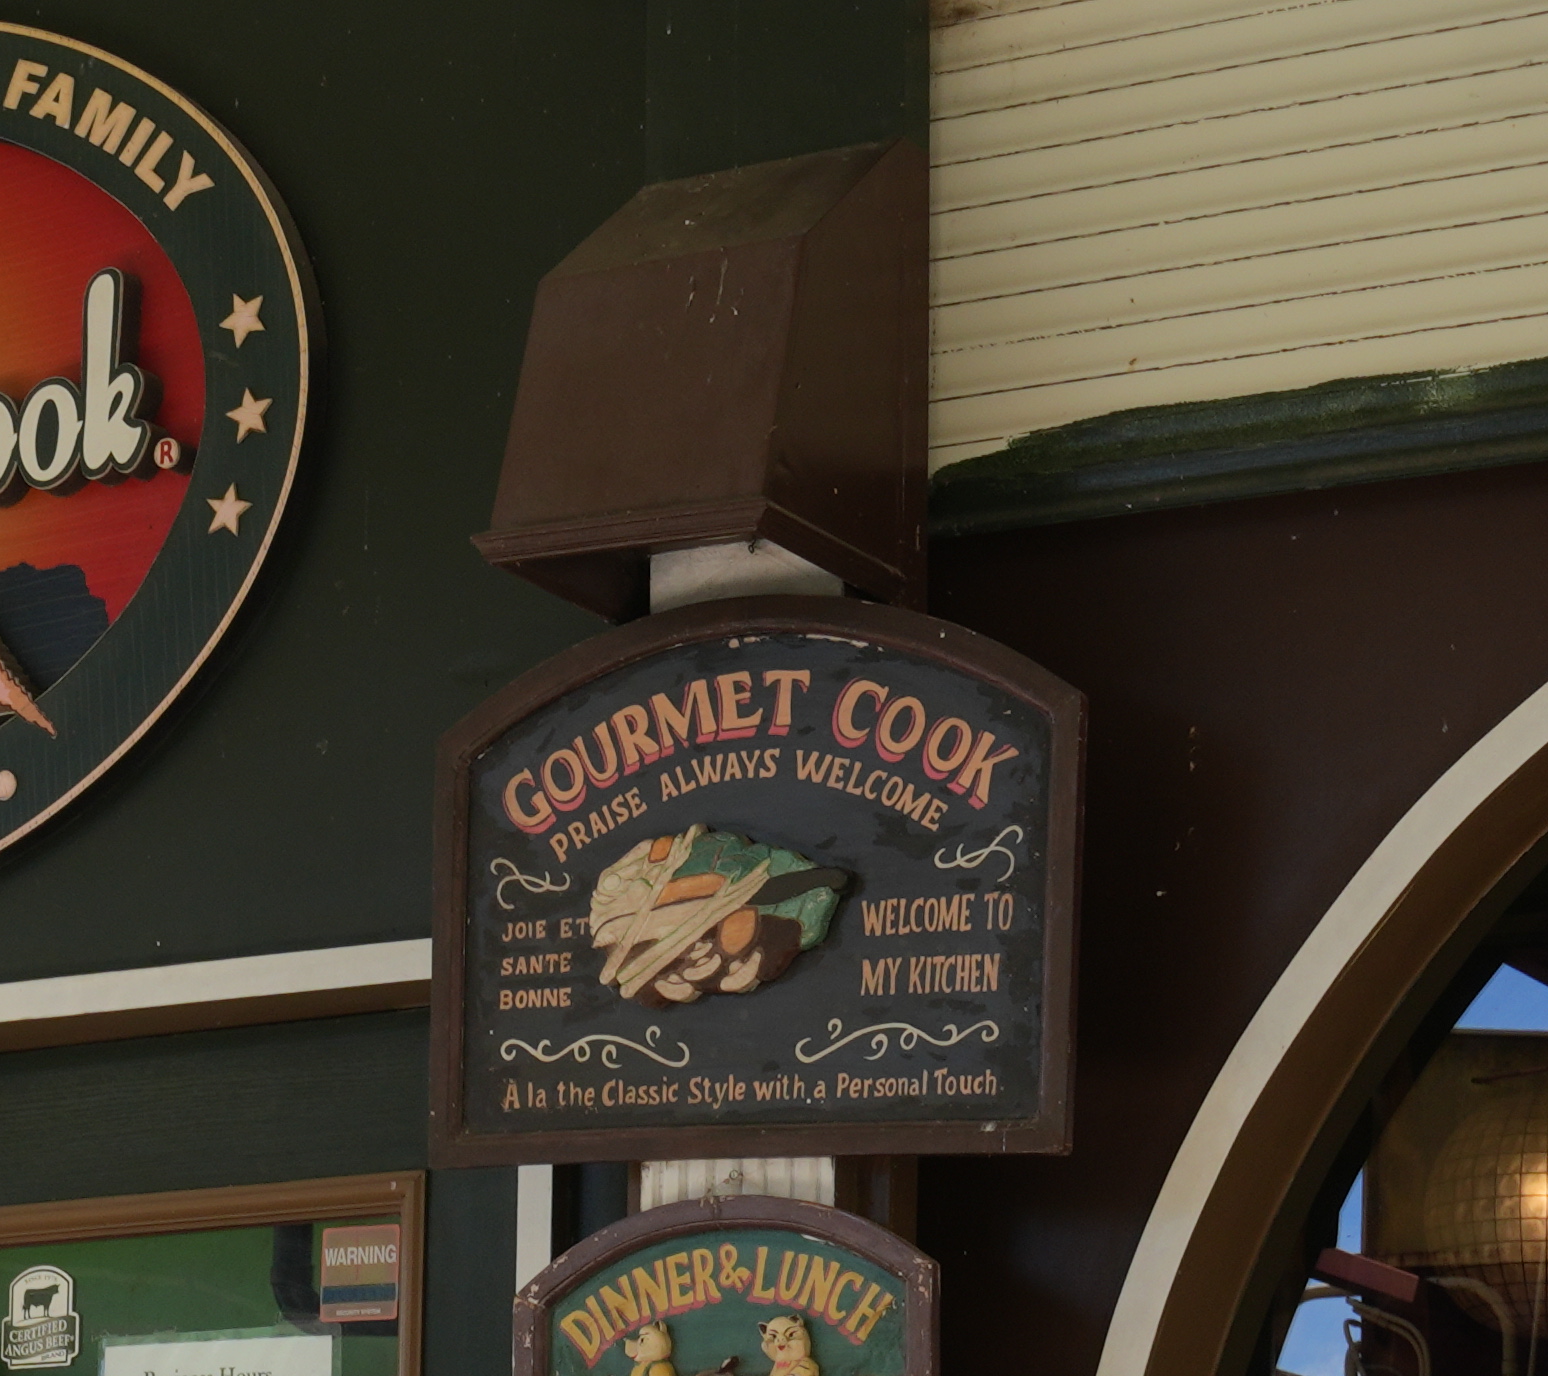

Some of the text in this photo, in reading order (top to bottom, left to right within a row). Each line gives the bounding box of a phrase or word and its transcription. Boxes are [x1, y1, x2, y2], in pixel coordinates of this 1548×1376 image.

[2, 59, 215, 213] FAMILY
[501, 669, 1021, 835] GOURMET COOK
[549, 747, 949, 863] PRAISE ALWAYS WELCOME
[502, 917, 590, 942] JOIE ET
[861, 890, 1014, 936] WELCOME TO
[501, 952, 572, 976] SANTE
[860, 953, 1001, 997] MY KITCHEN
[499, 987, 572, 1010] BONNE
[527, 1081, 547, 1108] la
[557, 1081, 596, 1107] the
[601, 1075, 679, 1105] Classic
[687, 1073, 746, 1109] Style
[753, 1073, 805, 1102] with
[813, 1079, 826, 1099] a
[836, 1069, 928, 1099] Personal
[934, 1067, 997, 1097] Touch
[325, 1244, 397, 1267] WARNING
[9, 1320, 68, 1343] CERTIFIED
[5, 1340, 43, 1357] ANGUS
